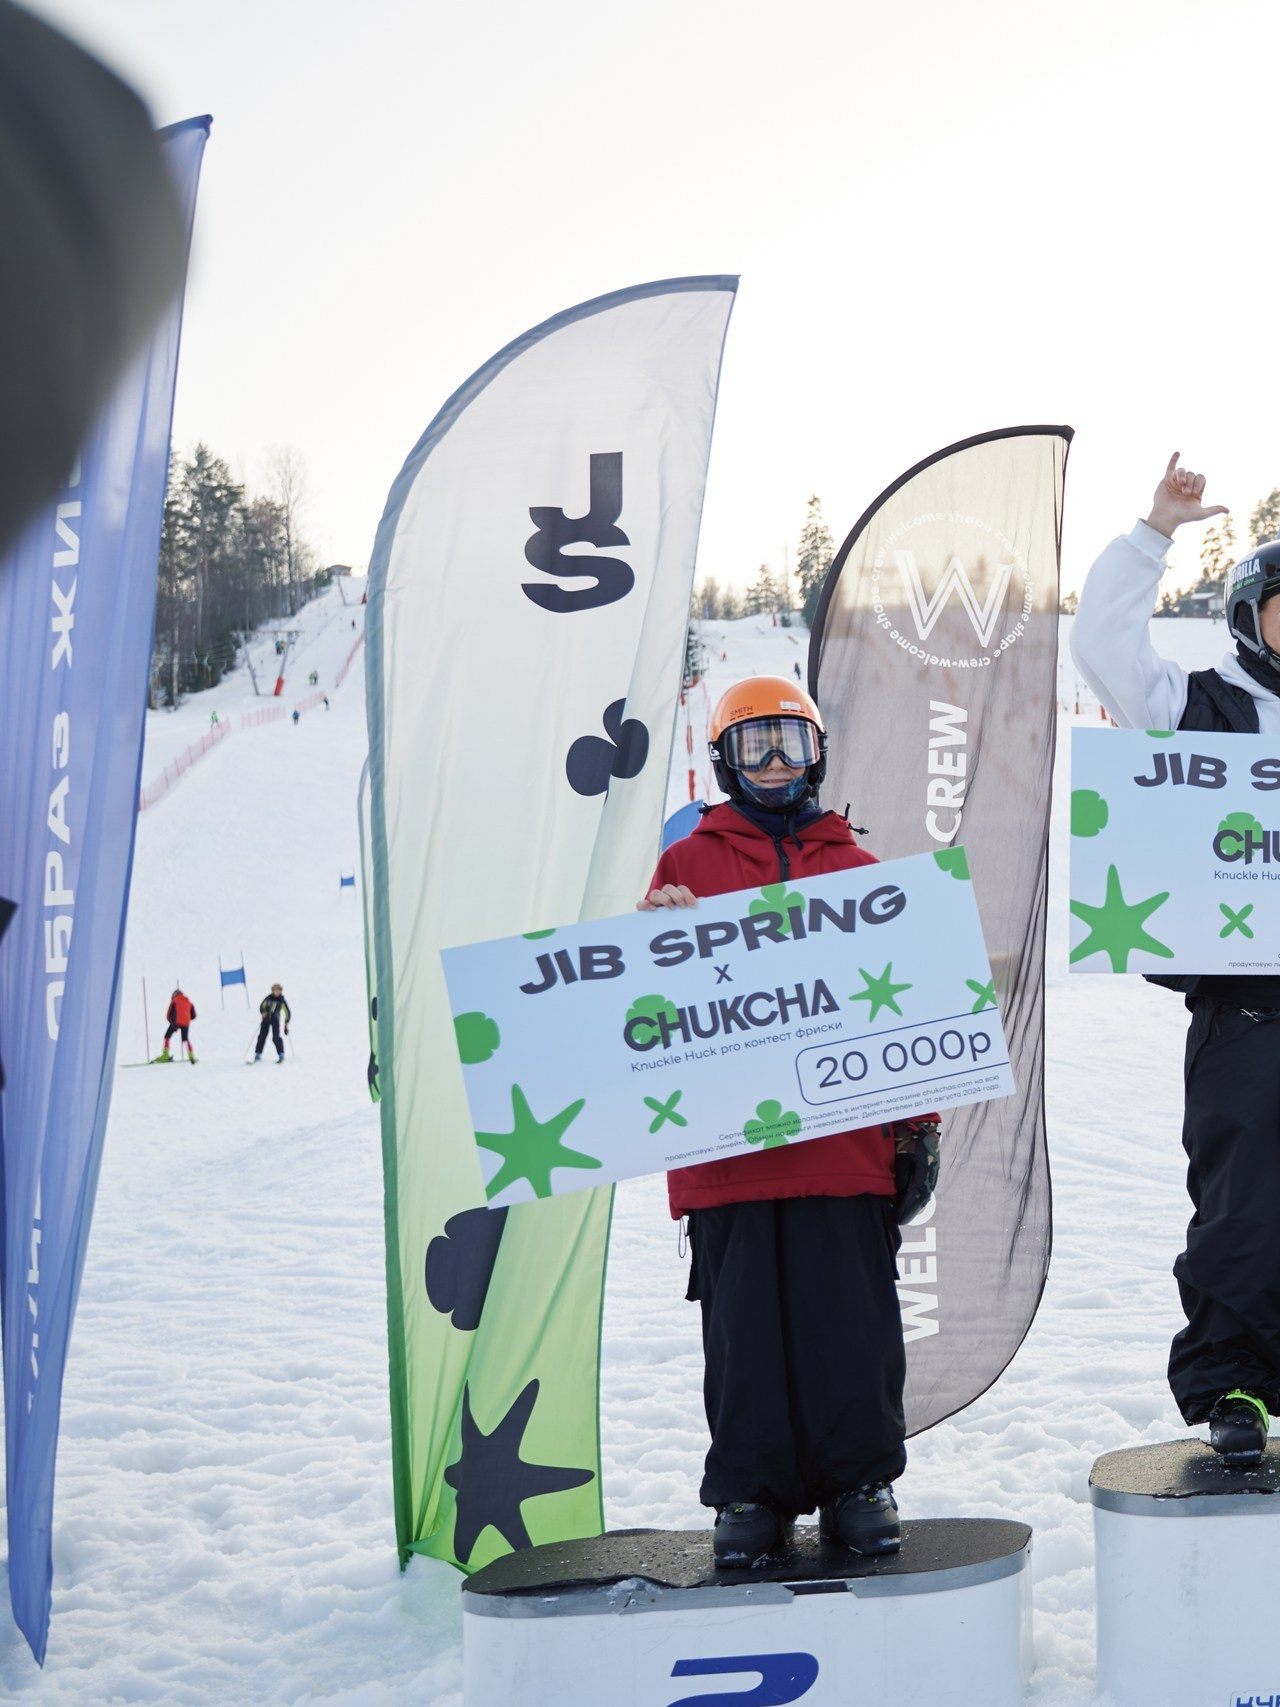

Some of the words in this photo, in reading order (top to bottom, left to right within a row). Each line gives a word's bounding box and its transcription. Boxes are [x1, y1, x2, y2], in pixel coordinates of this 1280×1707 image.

[52, 458, 82, 670] ЖИ
[1231, 558, 1261, 584] ORILLA
[895, 549, 1014, 648] W
[730, 706, 753, 717] SMITH
[925, 700, 968, 842] CREW
[1133, 752, 1227, 790] JIB
[1213, 870, 1258, 880] Knuckle
[519, 944, 626, 995] JIB
[649, 884, 907, 968] SPRING
[1228, 961, 1272, 969] продуктовую
[623, 979, 841, 1052] CHUKCHA
[630, 1055, 682, 1073] Knuckle
[685, 1046, 718, 1062] Huck
[720, 1042, 741, 1057] pro
[744, 1031, 792, 1049] контест
[795, 1021, 843, 1040] фриски
[815, 1051, 868, 1089] 20
[664, 1146, 715, 1162] продуктовую
[861, 1103, 913, 1120] Действителен
[934, 1092, 962, 1103] августа
[963, 1087, 981, 1096] 2024
[718, 1125, 764, 1141] Сертификат
[765, 1120, 792, 1131] можно
[793, 1110, 843, 1124] использовать
[849, 1092, 921, 1113] интернет-магазине
[922, 1080, 973, 1097] chukchas.com
